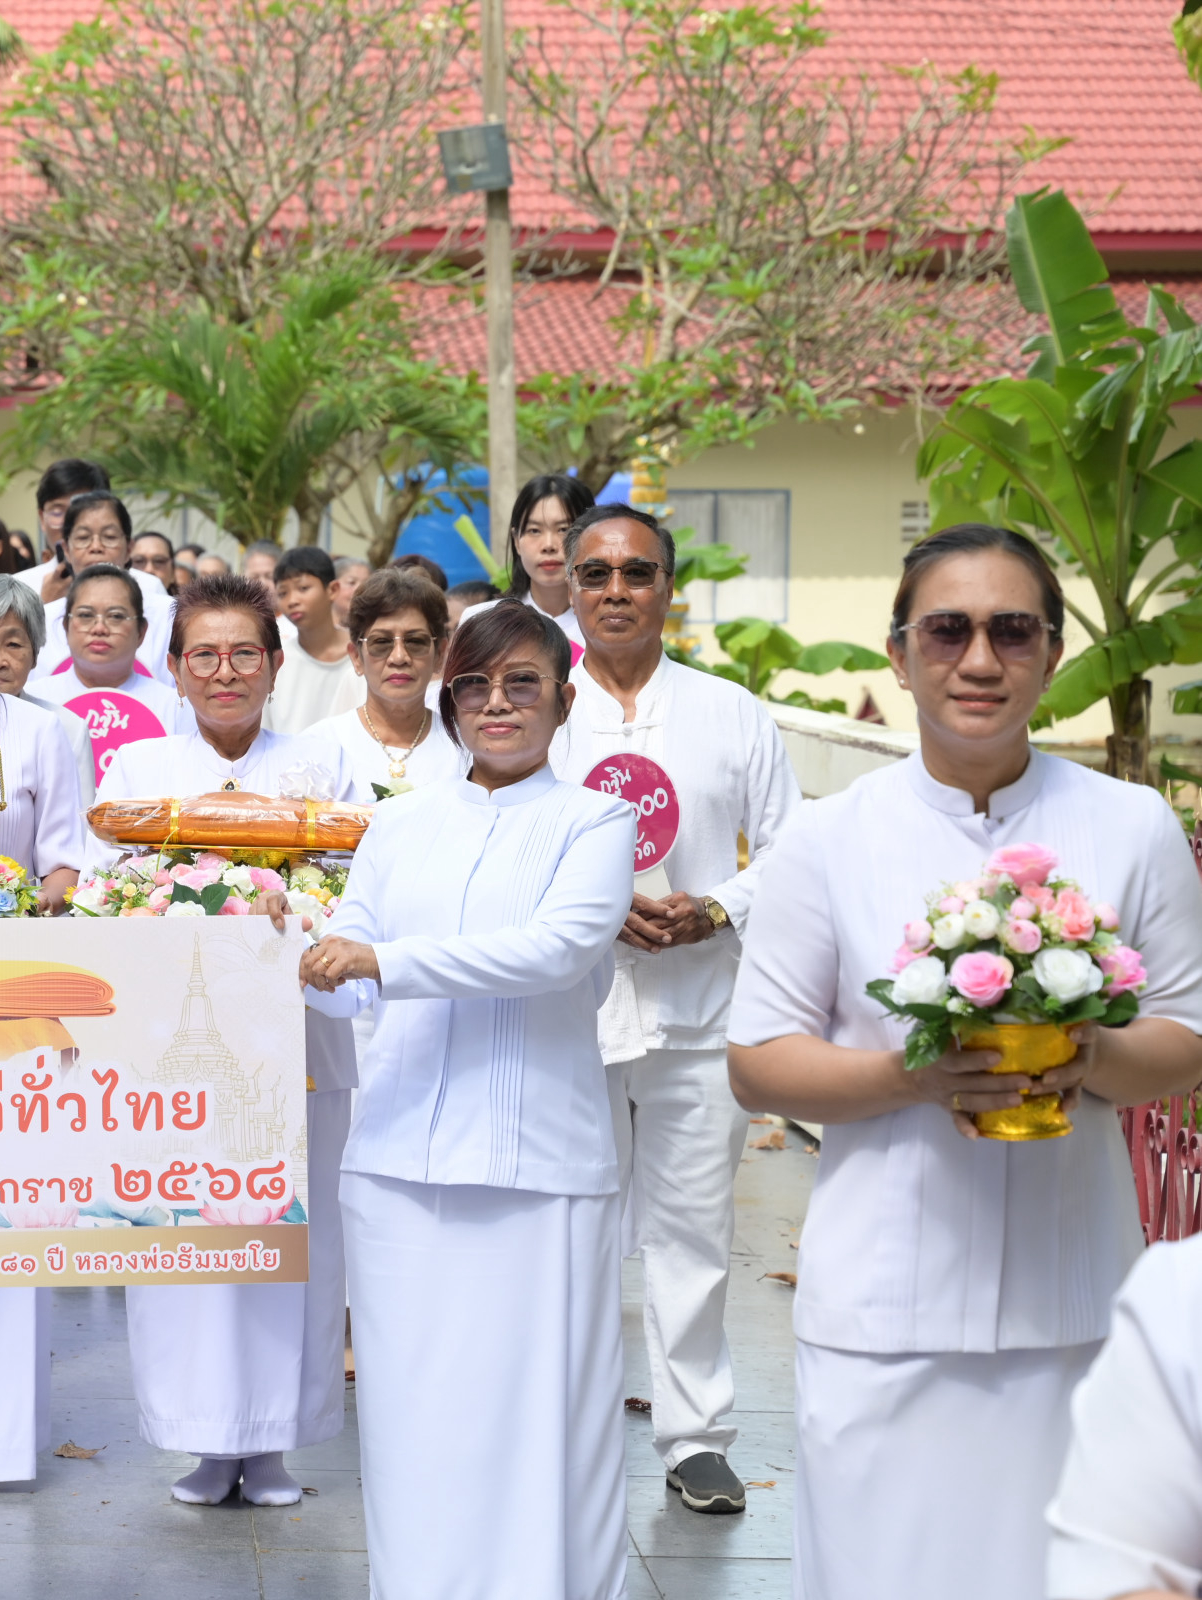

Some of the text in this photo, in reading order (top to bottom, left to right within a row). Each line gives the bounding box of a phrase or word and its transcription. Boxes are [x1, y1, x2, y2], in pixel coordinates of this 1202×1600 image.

[85, 698, 130, 739] กฐิน
[110, 1160, 286, 1203] ๒๕๖๘
[1, 1255, 37, 1273] ๘๑
[47, 1247, 64, 1271] ปี
[76, 1243, 278, 1271] หลวงพ่อธัมมชโย
